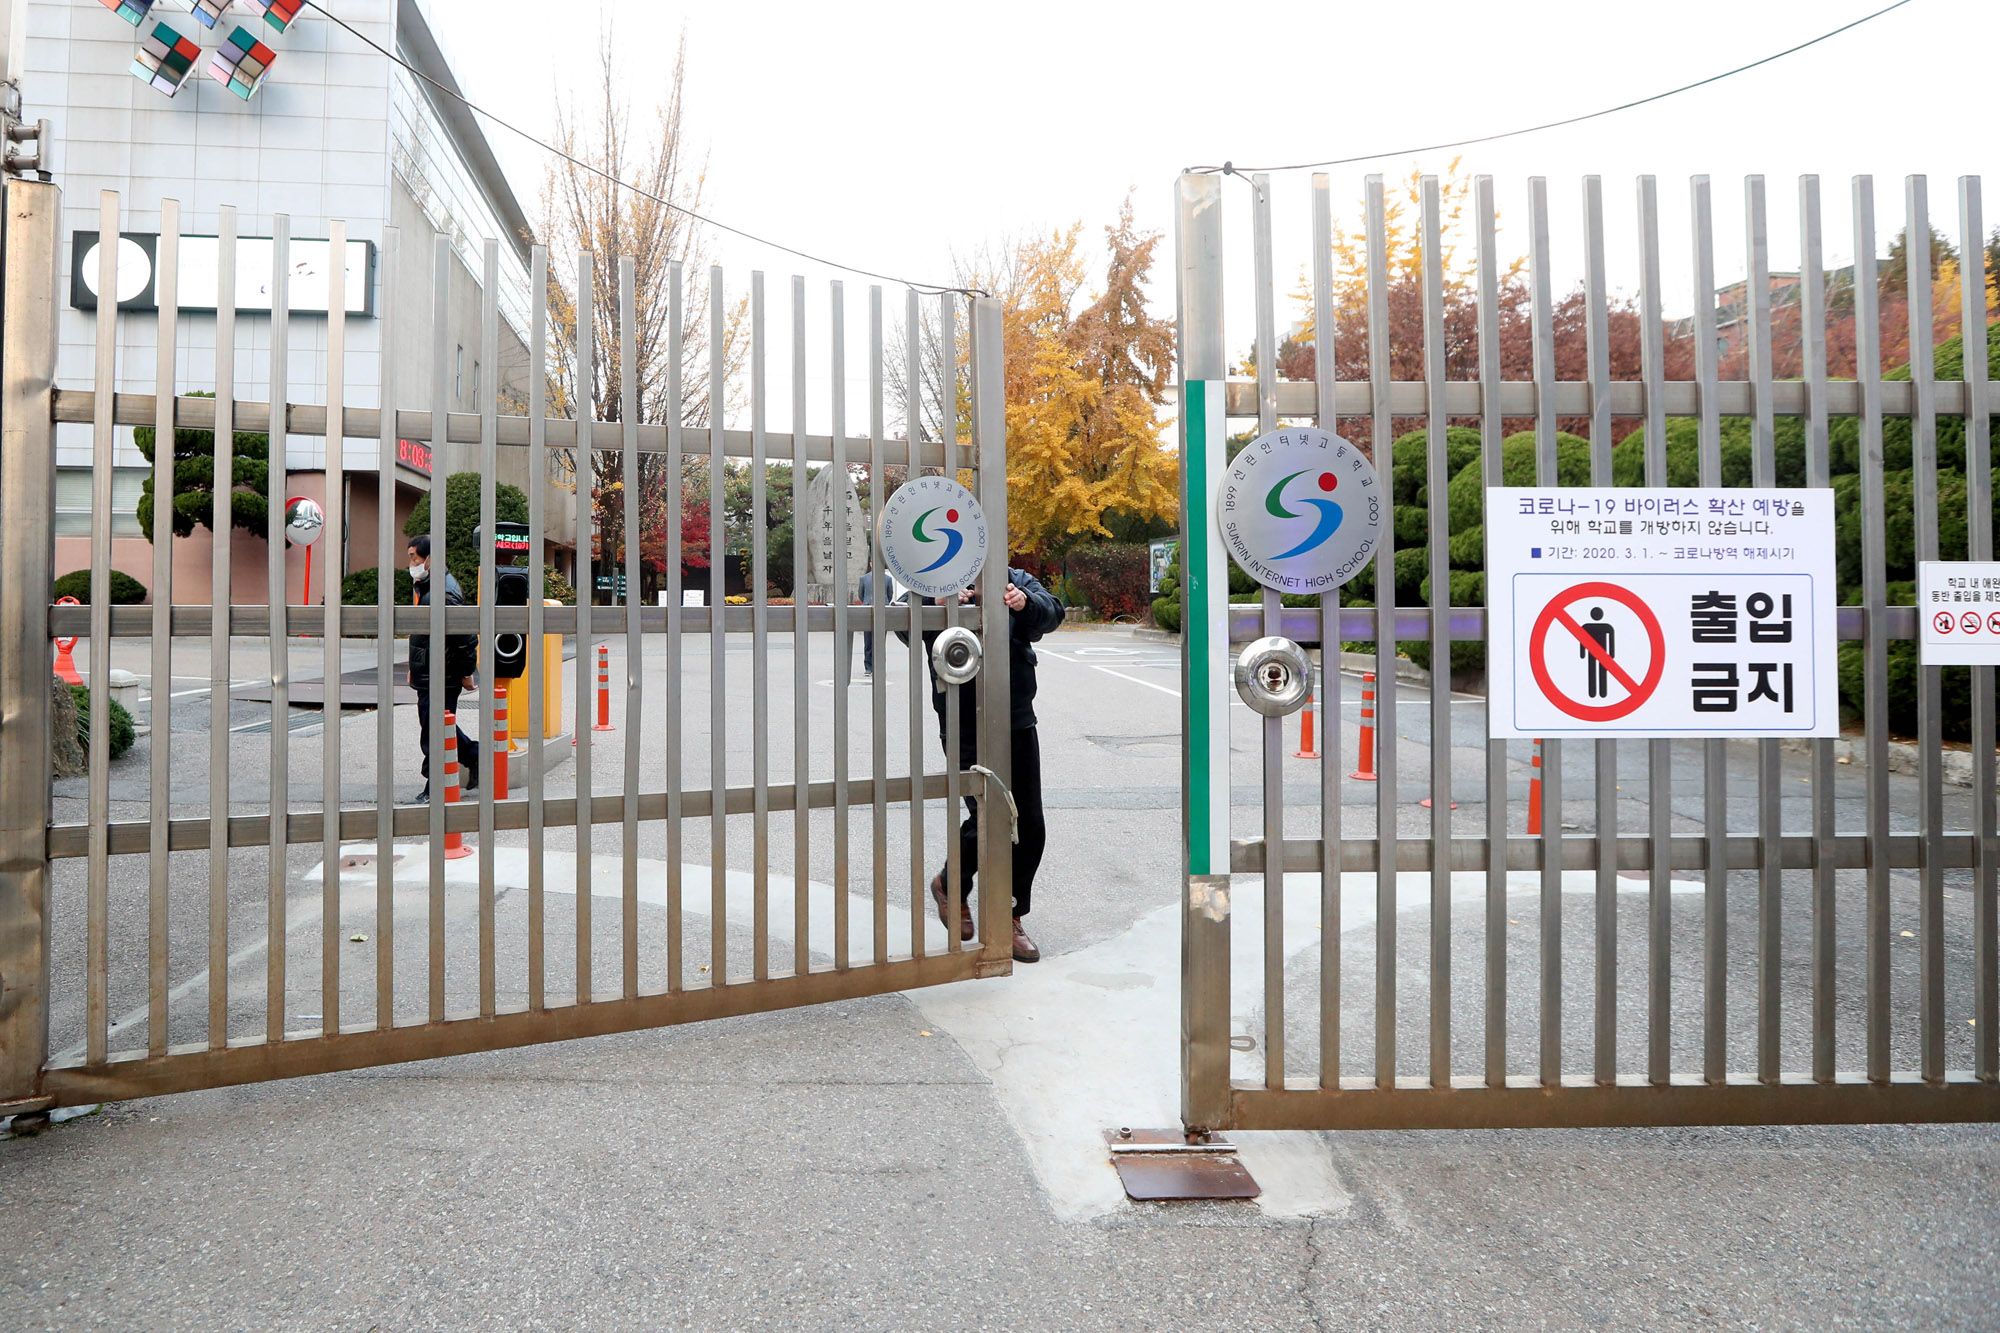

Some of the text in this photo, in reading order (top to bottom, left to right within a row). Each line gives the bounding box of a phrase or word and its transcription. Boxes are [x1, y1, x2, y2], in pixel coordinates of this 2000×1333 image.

[1225, 434, 1379, 527] 1899 선린인터넷고등학교 2001
[1519, 498, 1805, 517] 코로나-19 바이러스 확산 예방을
[885, 519, 893, 538] 1899
[977, 526, 986, 549] 2001
[1551, 520, 1774, 536] 위해 학교를 개방하지 않습니다.
[1226, 522, 1375, 588] SUNRIN INTERNET HIGH SCHOOL
[1548, 547, 1578, 560] 기간:
[1583, 547, 1620, 559] 2020.
[1625, 547, 1637, 559] 3.
[1642, 547, 1655, 559] 1.
[1674, 547, 1738, 560] 코로나방역
[1743, 547, 1795, 560] 해제시기
[886, 546, 983, 593] SUNRIN INTERNET HIGH SCHOOL
[1947, 577, 1967, 589] 학교
[1970, 577, 1979, 589] 내
[1931, 590, 1950, 603] 동반
[1953, 590, 1982, 603] 출입을
[1690, 591, 1794, 644] 출입
[1690, 663, 1794, 714] 금지
